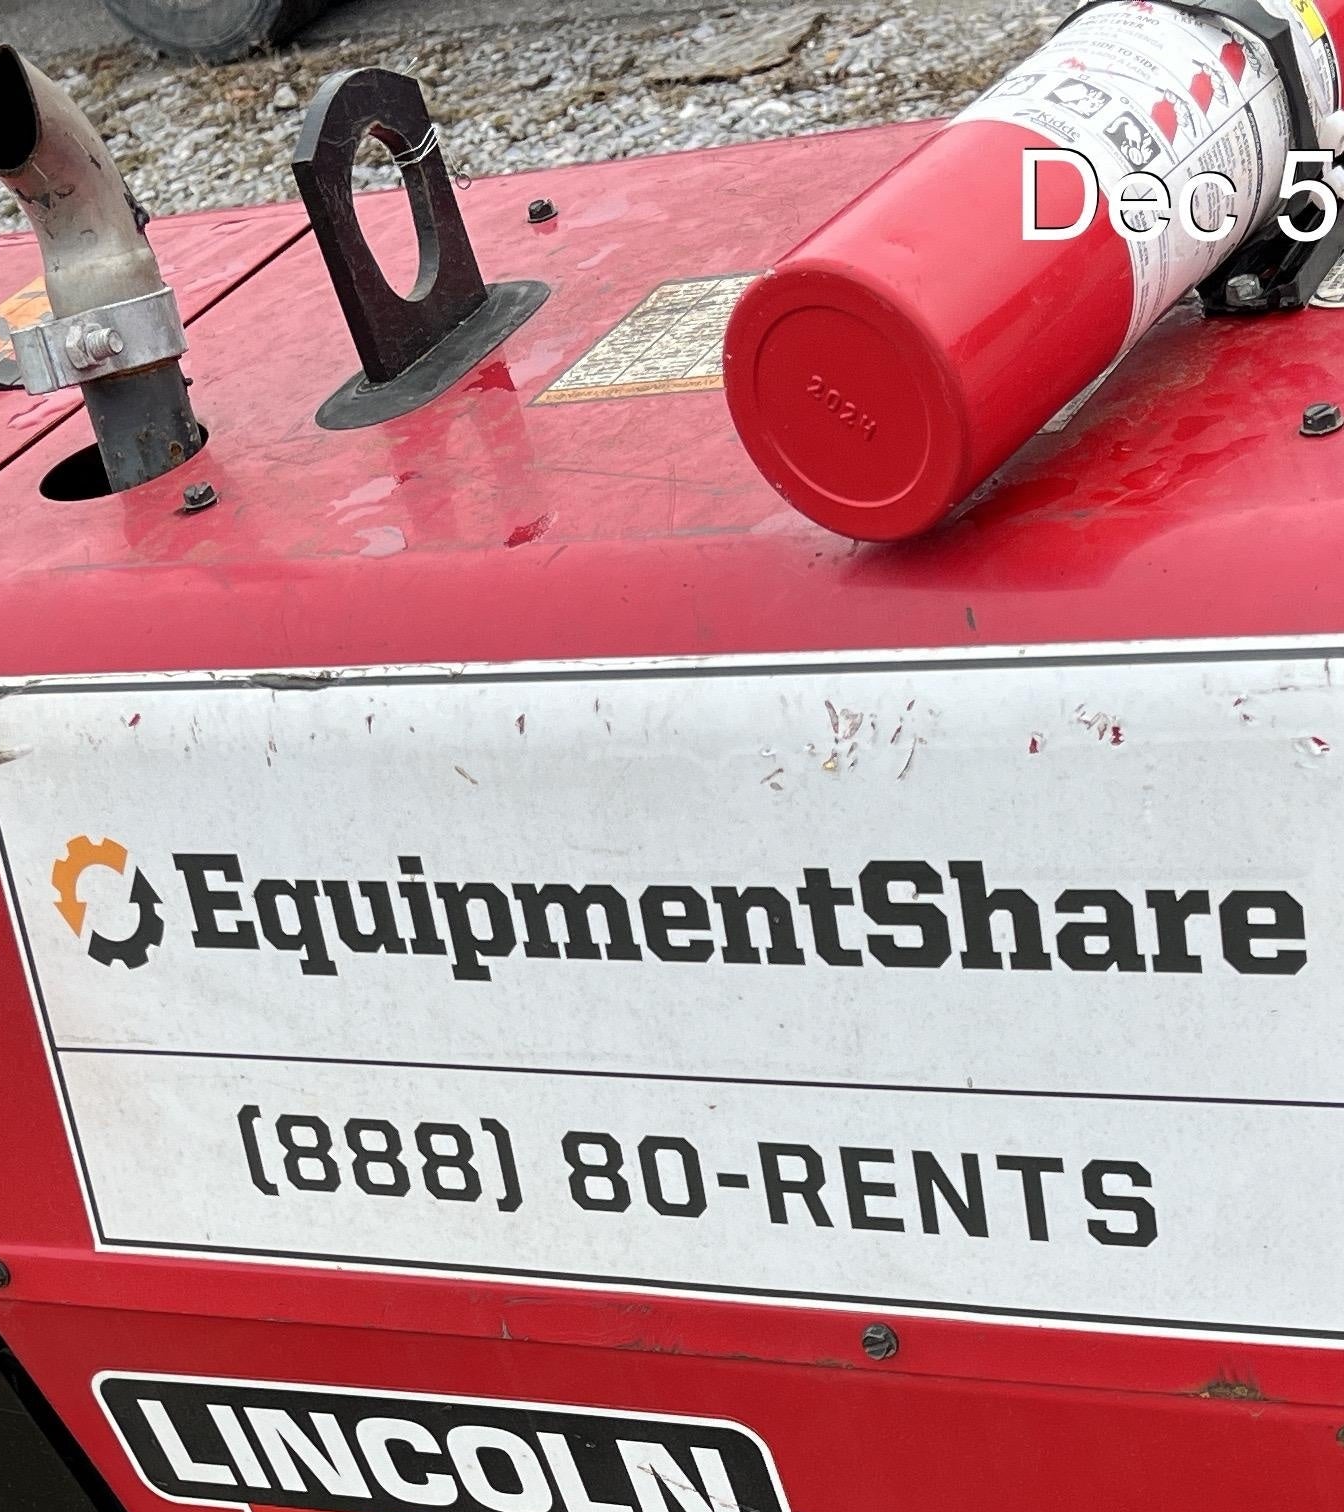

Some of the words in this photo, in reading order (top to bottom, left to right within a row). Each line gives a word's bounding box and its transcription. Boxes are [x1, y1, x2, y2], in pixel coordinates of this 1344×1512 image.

[1035, 109, 1082, 141] Kidde
[805, 374, 878, 444] 2024
[171, 850, 1309, 983] EquipmentShare
[236, 1103, 523, 1214] (888)
[560, 1129, 1160, 1250] 80-RENTS
